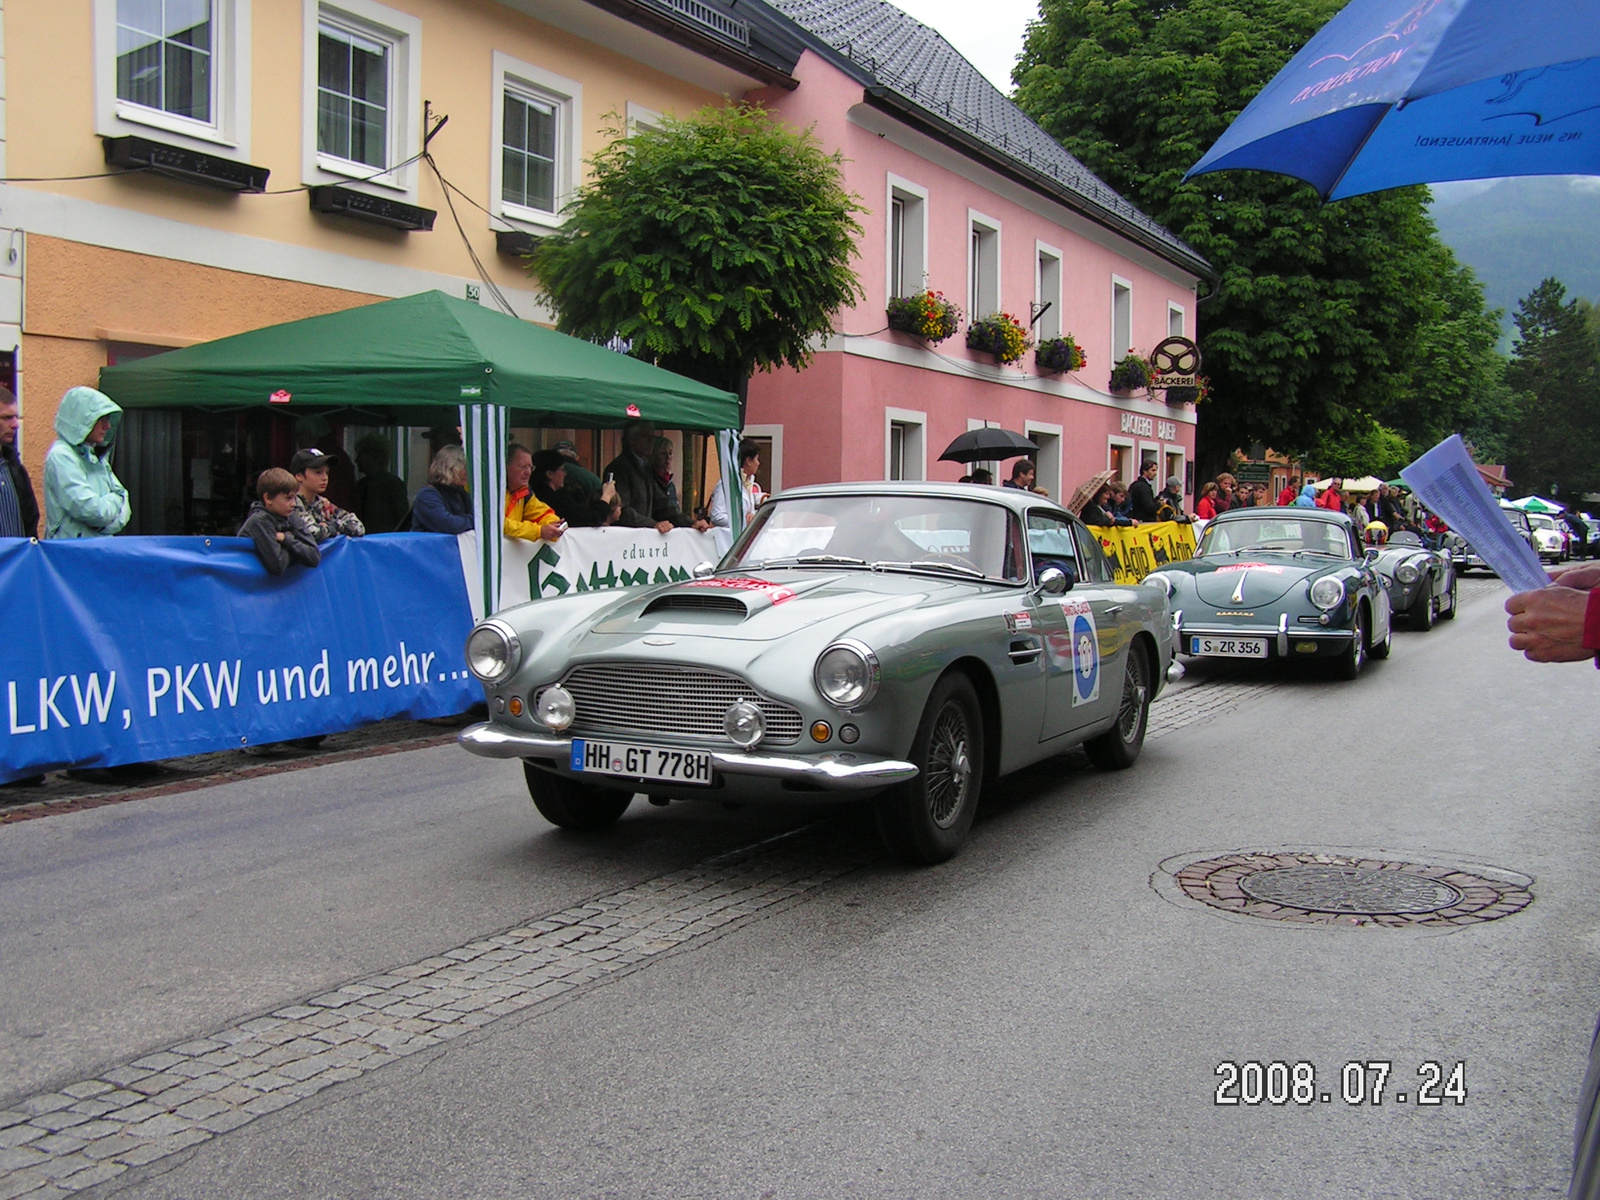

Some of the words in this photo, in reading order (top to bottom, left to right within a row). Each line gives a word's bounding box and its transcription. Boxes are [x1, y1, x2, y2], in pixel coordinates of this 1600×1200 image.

[467, 285, 480, 299] 50
[1154, 376, 1194, 386] BÄCKEREI
[622, 542, 669, 560] eduard
[1203, 640, 1212, 652] S
[1220, 641, 1236, 653] ZR
[1238, 641, 1261, 654] 356
[8, 670, 132, 735] LKW,
[147, 659, 242, 717] PKW
[257, 649, 331, 705] und
[347, 641, 469, 693] mehr...
[585, 743, 611, 769] HH
[626, 748, 652, 774] GT
[658, 751, 709, 780] 778H
